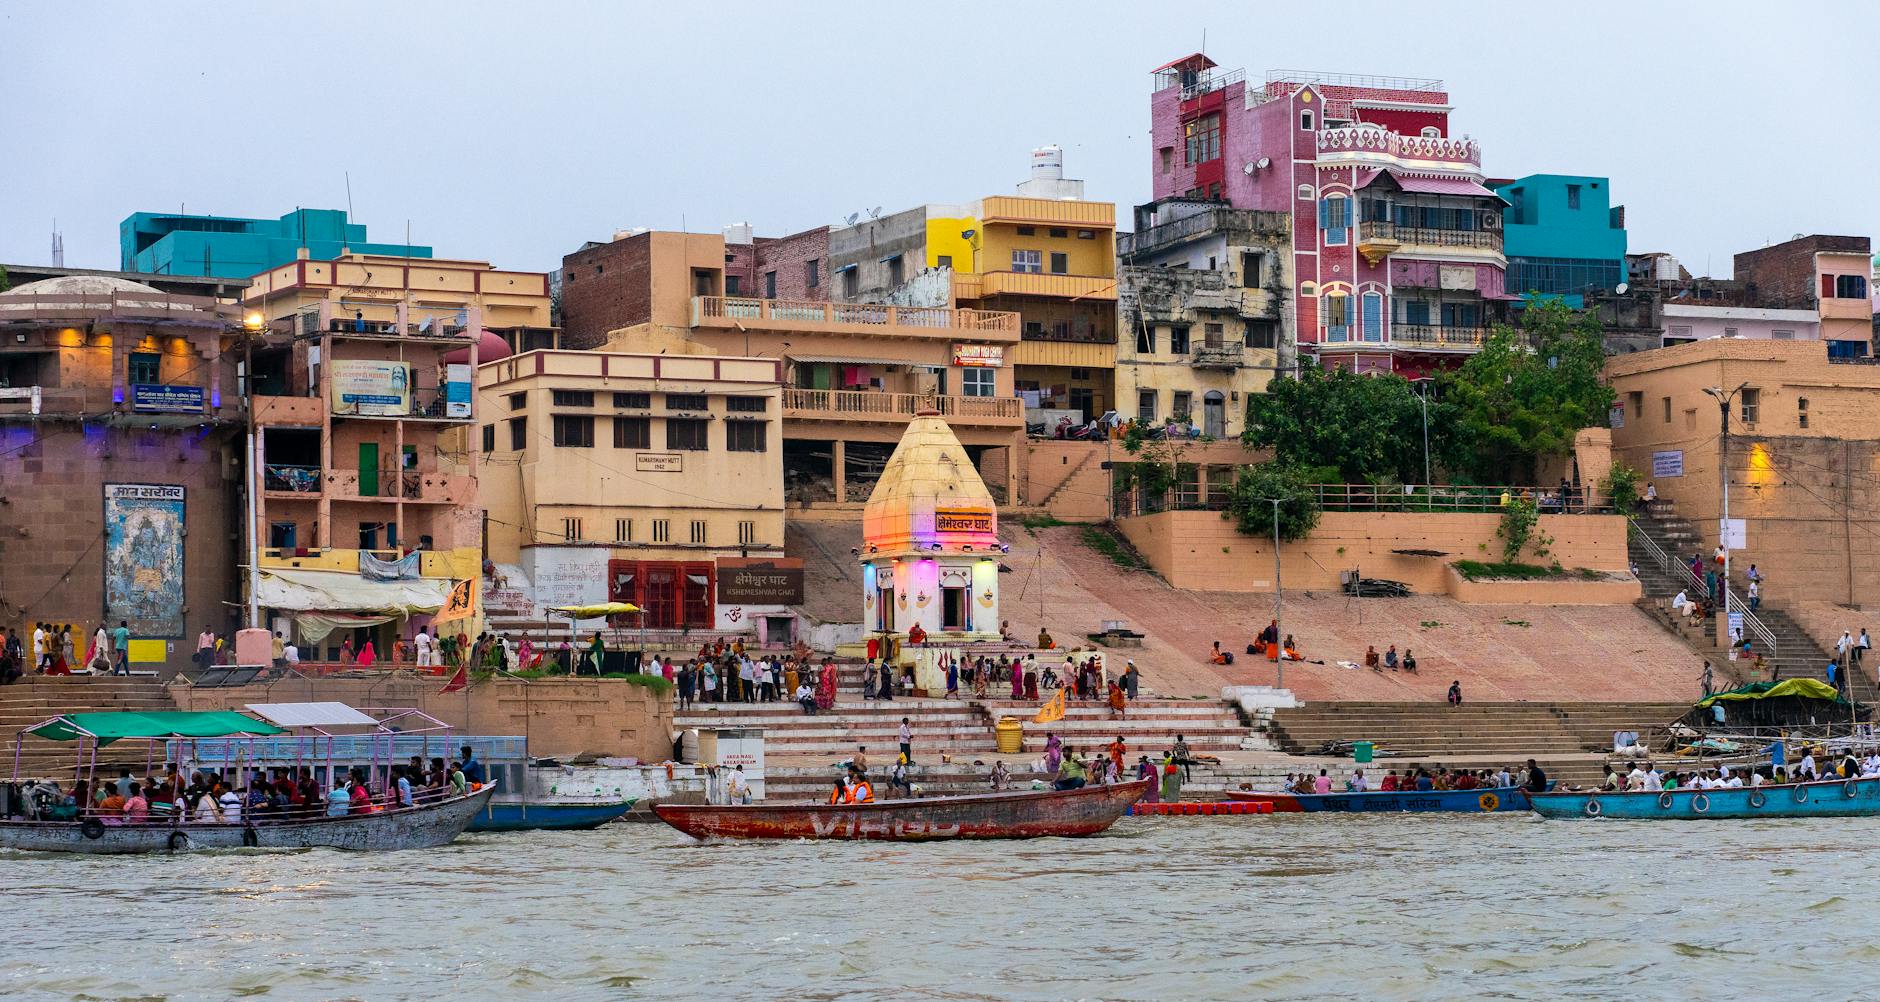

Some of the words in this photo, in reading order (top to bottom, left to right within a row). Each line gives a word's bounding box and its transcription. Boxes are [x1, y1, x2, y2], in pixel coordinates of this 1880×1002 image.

[974, 519, 990, 529] घाट
[769, 575, 788, 585] घाट
[777, 588, 795, 596] GHAT
